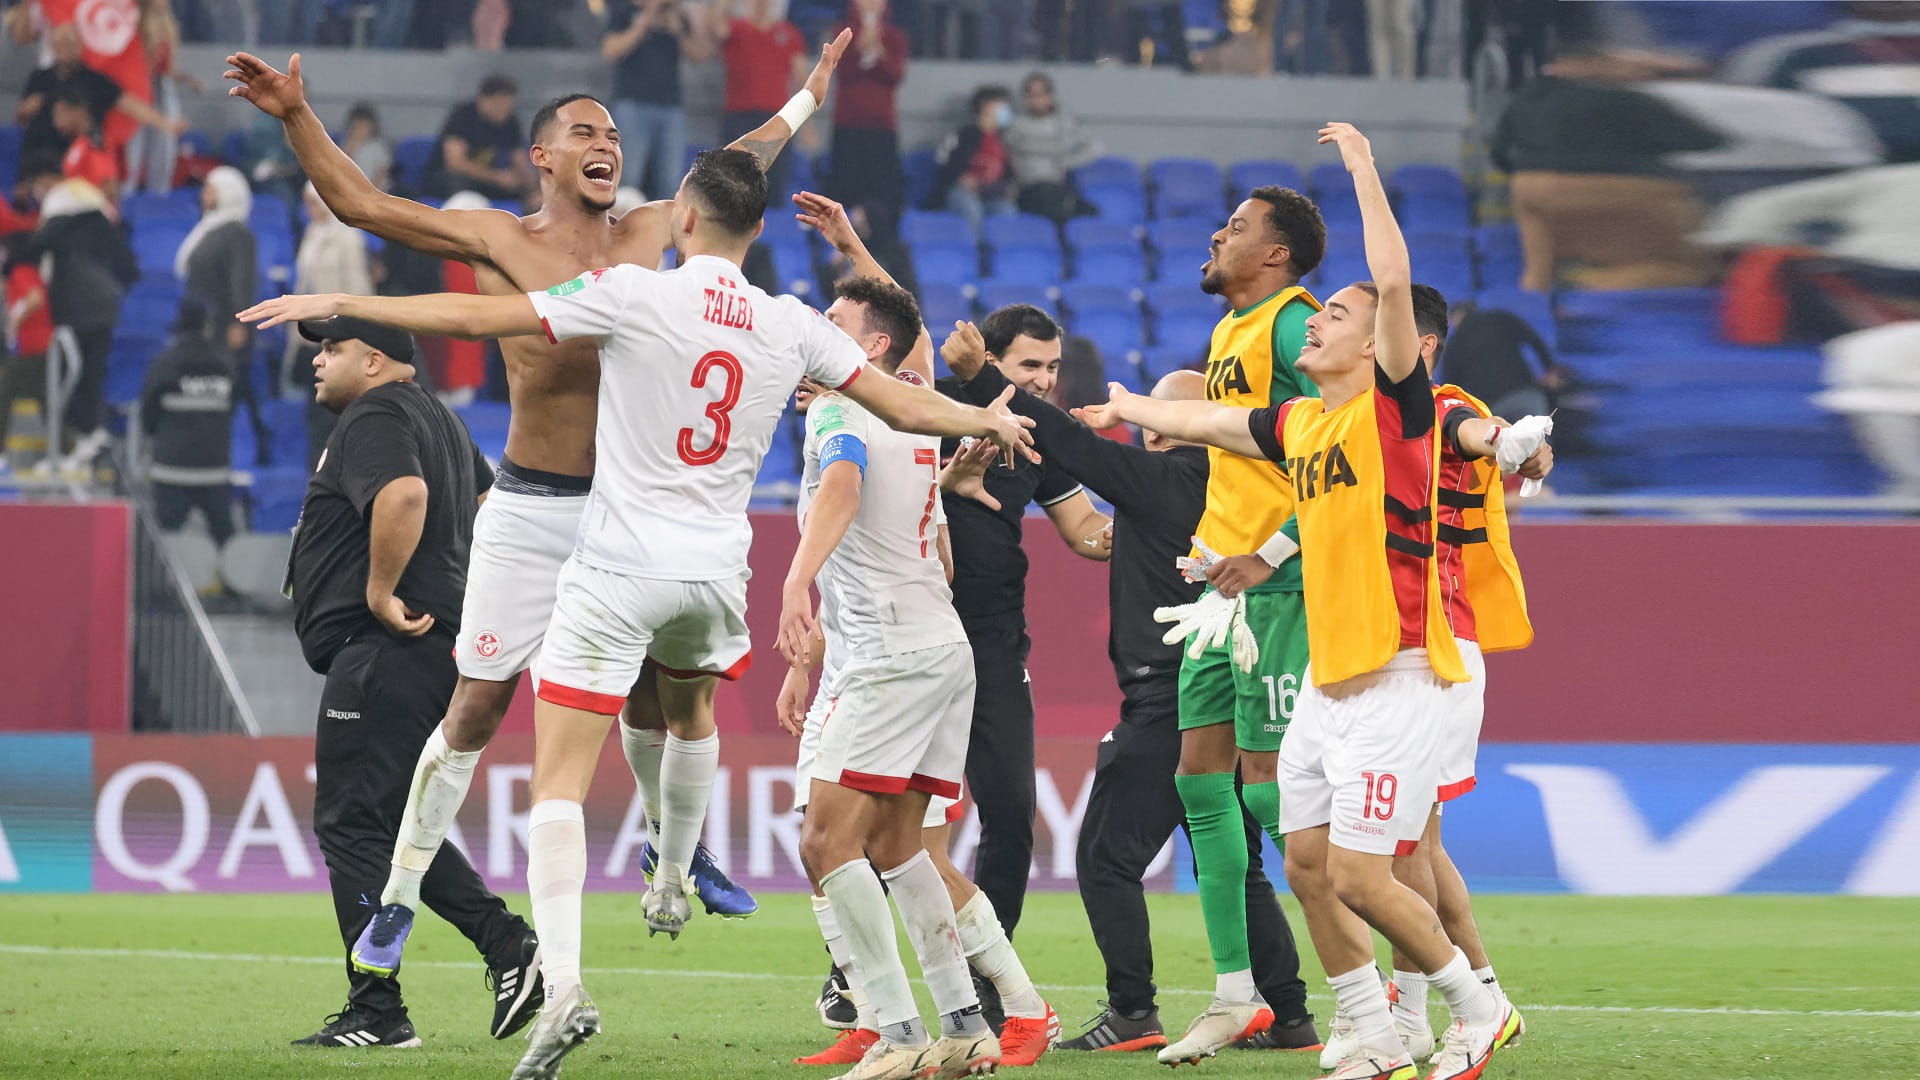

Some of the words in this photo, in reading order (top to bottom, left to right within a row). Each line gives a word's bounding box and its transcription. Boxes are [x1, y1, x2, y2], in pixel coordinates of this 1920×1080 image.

[703, 288, 753, 331] TALBI
[1206, 355, 1253, 401] IFA
[677, 350, 744, 467] 3
[914, 448, 937, 559] 7
[326, 708, 361, 720] Kappa
[1262, 673, 1298, 721] 16
[1361, 772, 1398, 821] 19
